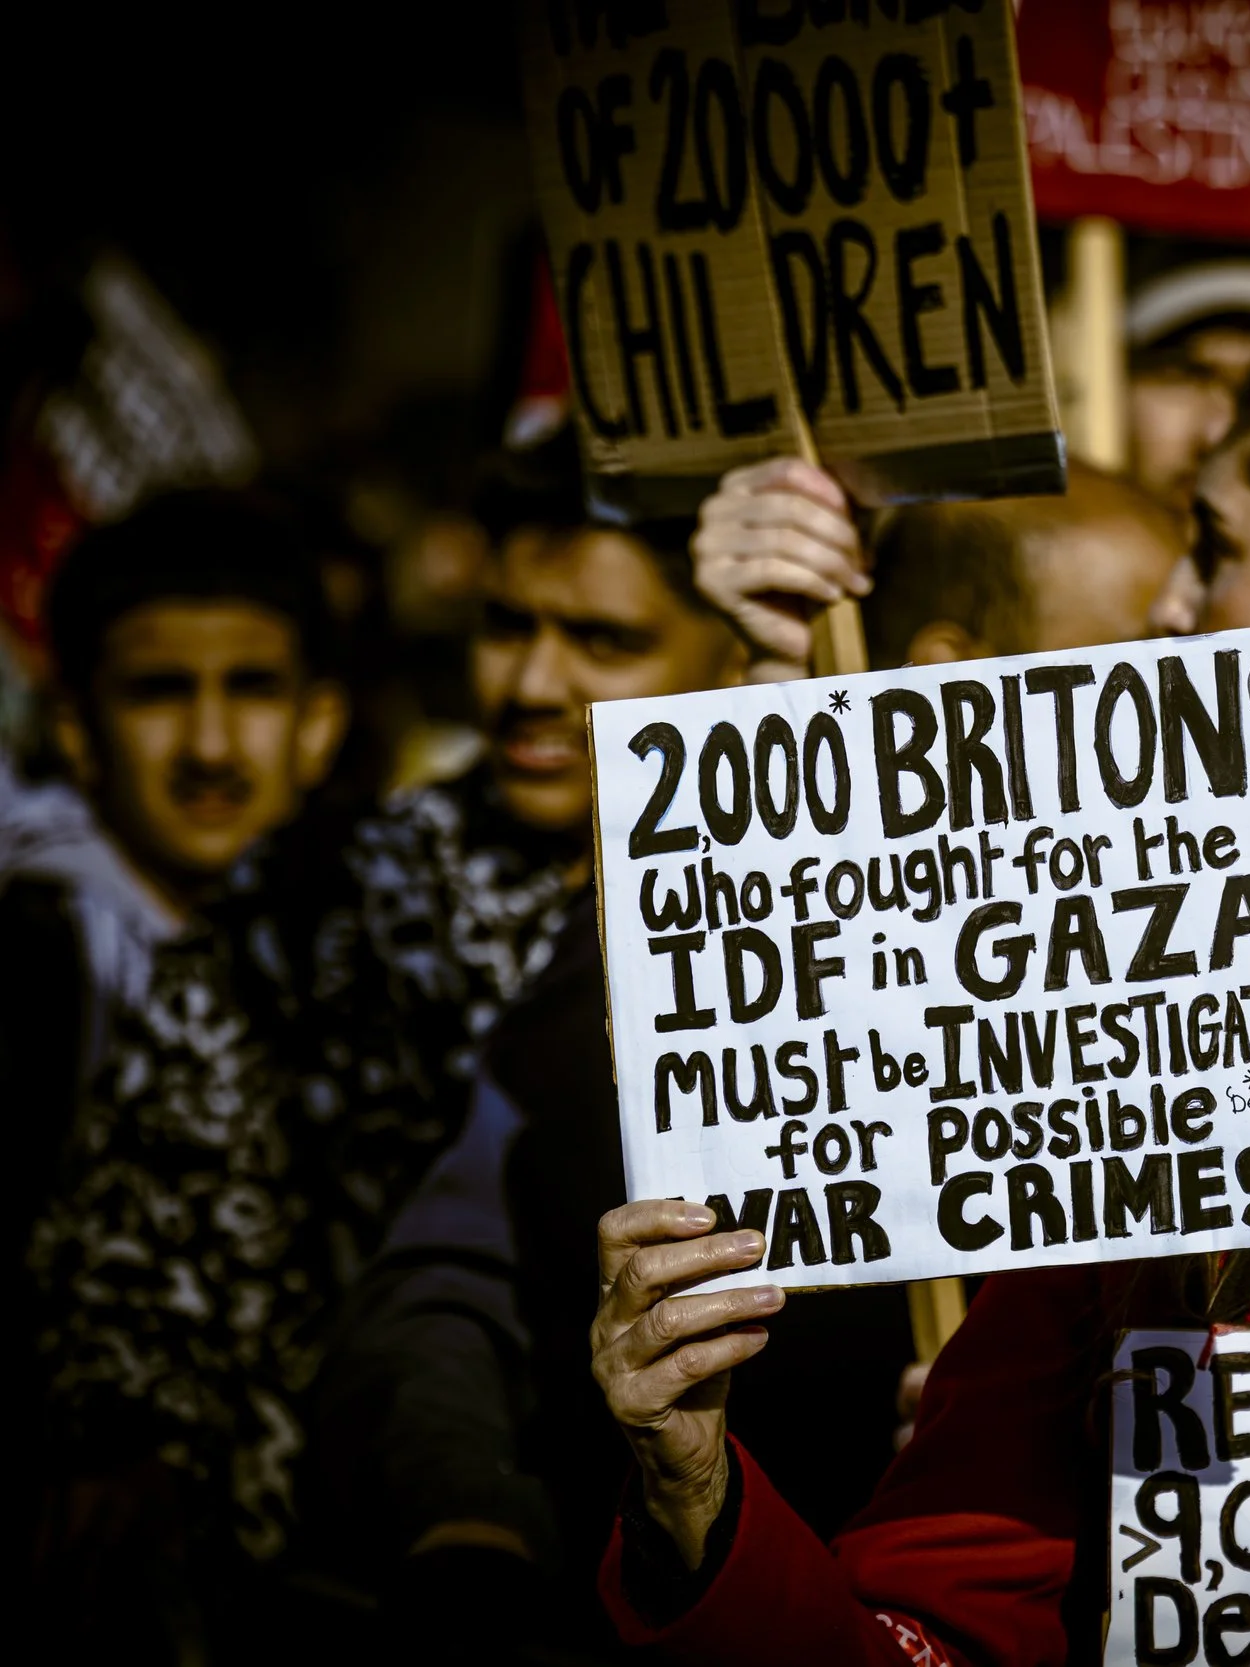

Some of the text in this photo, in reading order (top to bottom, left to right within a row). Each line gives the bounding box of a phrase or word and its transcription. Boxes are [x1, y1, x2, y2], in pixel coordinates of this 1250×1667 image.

[557, 76, 635, 212] OF
[567, 211, 1026, 439] CHILDREN
[781, 831, 1003, 922] fought
[1013, 826, 1112, 894] for
[1133, 816, 1241, 880] the
[647, 919, 846, 1033] IDF
[872, 931, 928, 991] in
[867, 1028, 929, 1092] be
[764, 1119, 894, 1179] for
[927, 1083, 1217, 1186] possible
